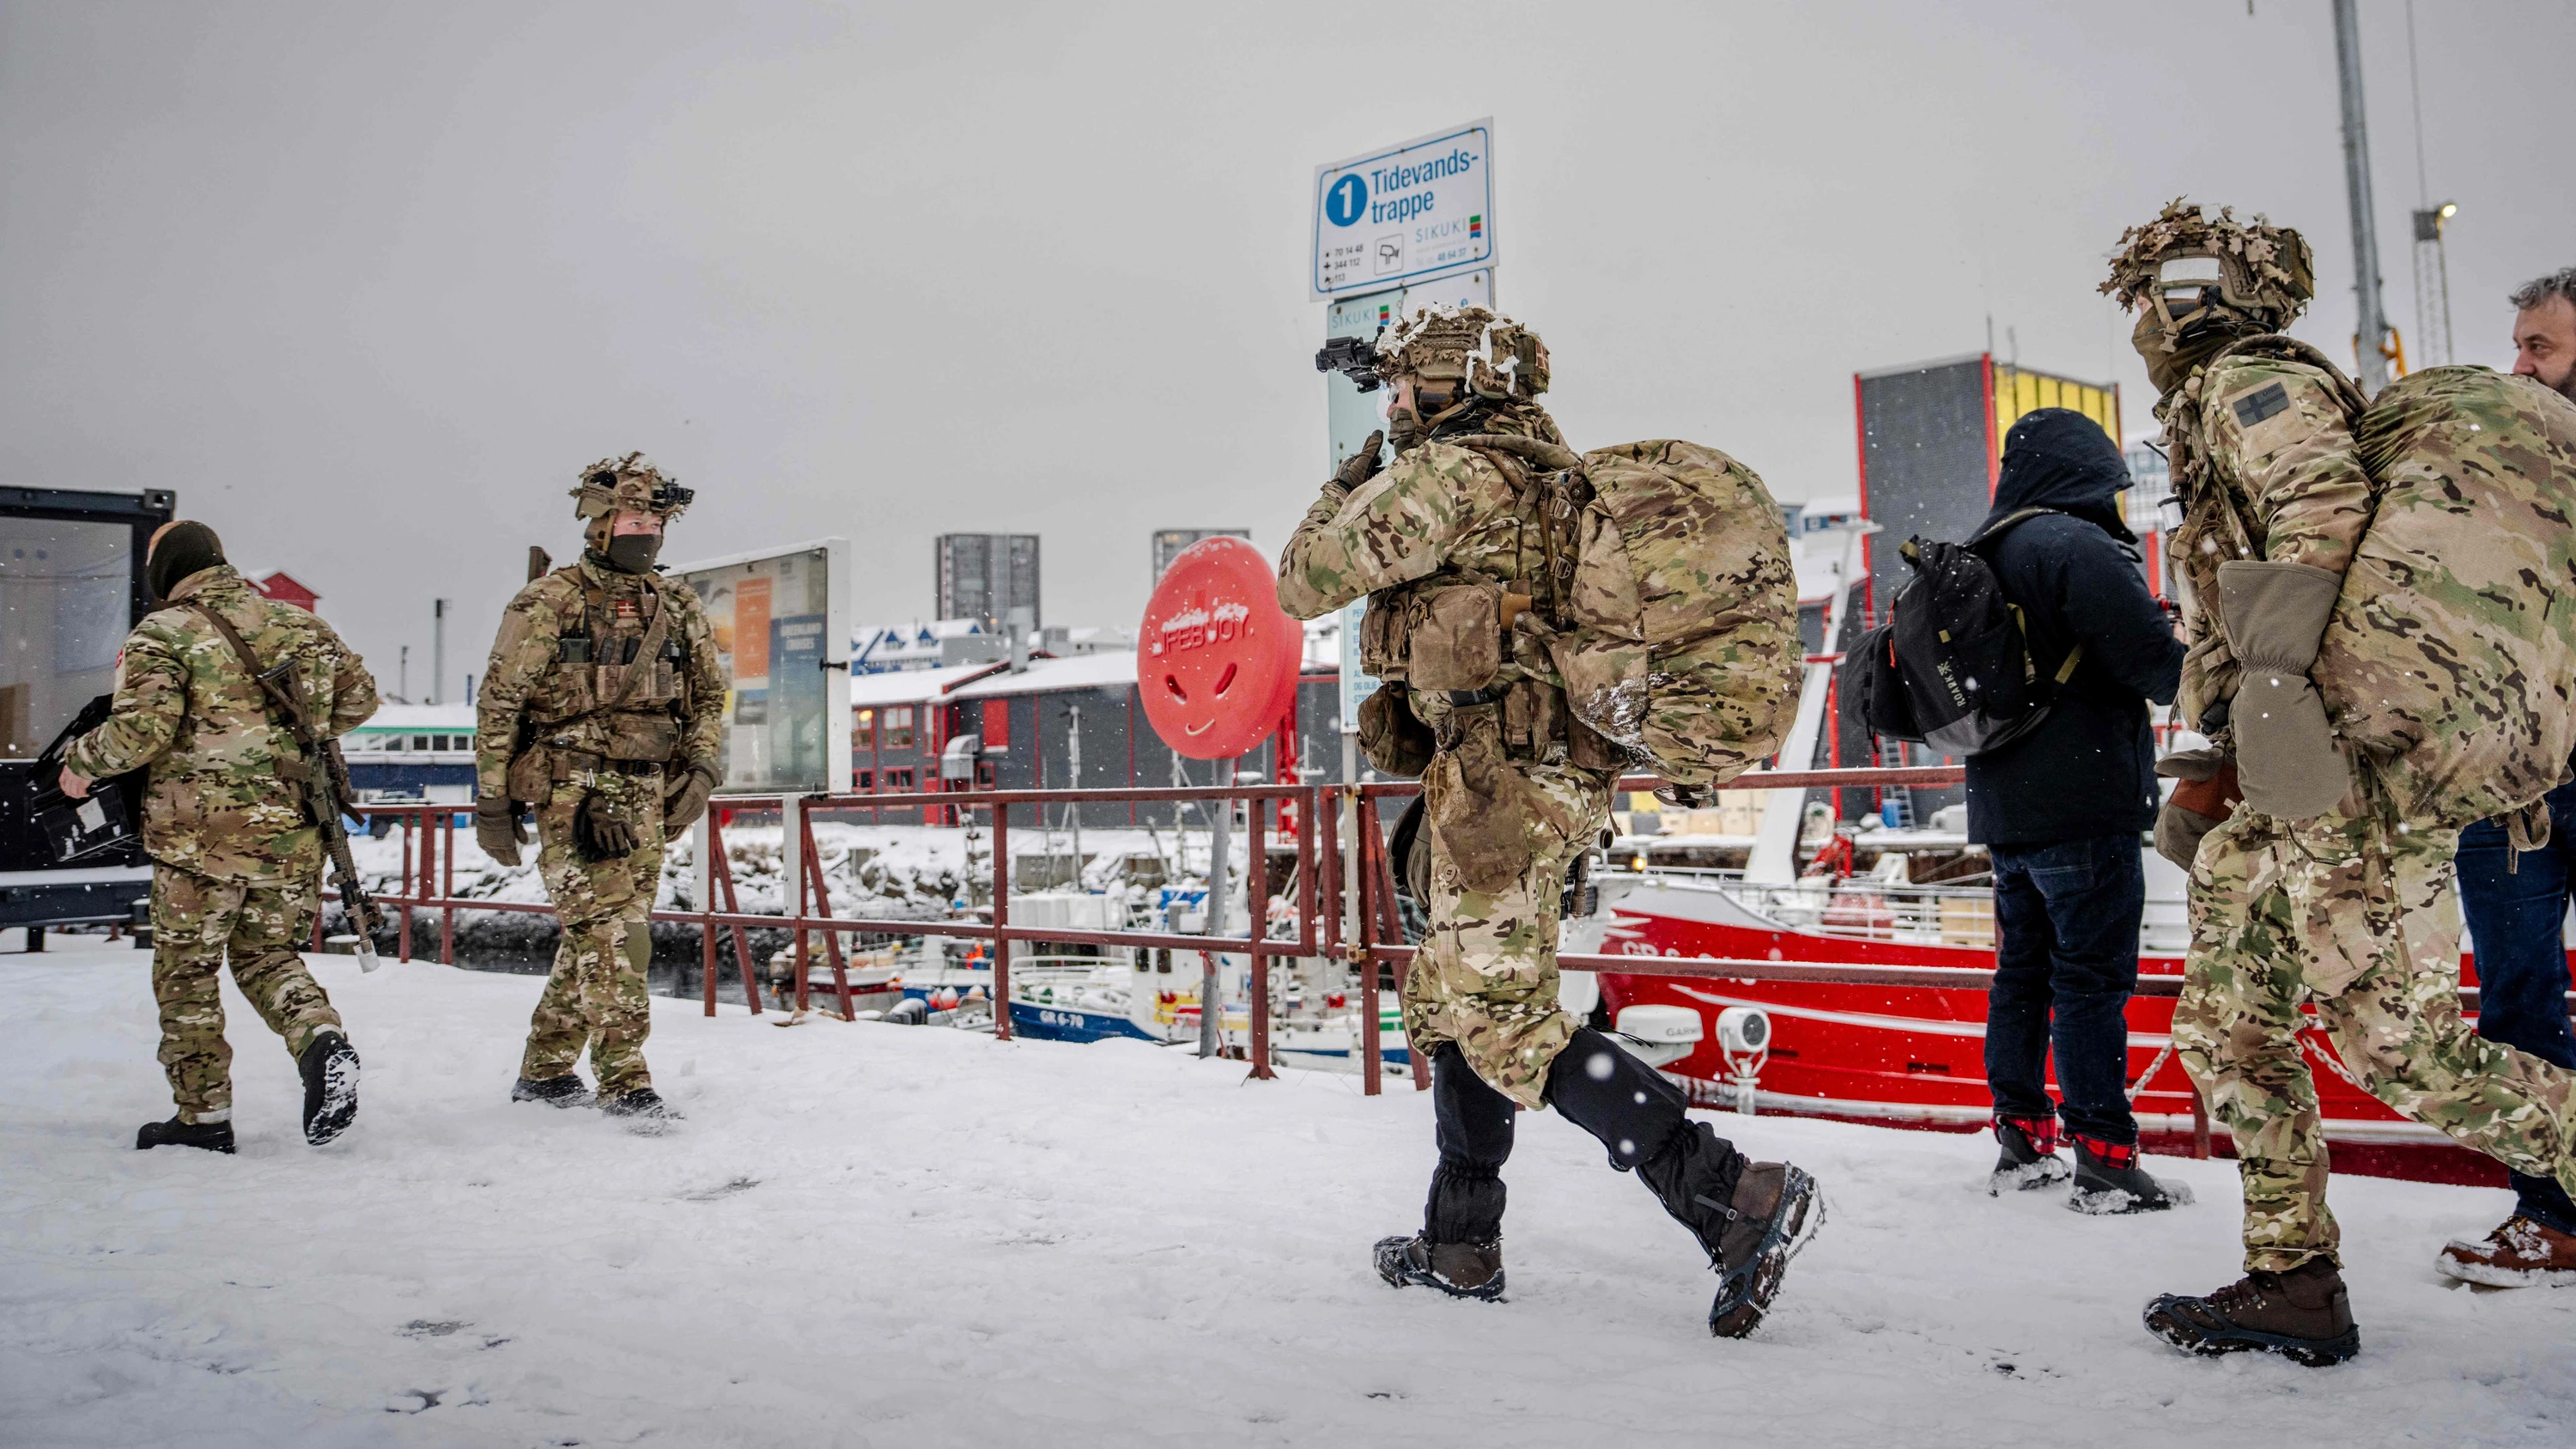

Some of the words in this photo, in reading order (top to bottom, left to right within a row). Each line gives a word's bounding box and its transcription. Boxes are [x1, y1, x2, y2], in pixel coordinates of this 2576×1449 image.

[1371, 149, 1479, 195] Tidevands-
[1338, 180, 1354, 219] 1
[1371, 190, 1434, 224] trappe
[1416, 217, 1467, 243] SIKUKI
[1332, 307, 1376, 329] SIKUKI
[1944, 673, 1966, 707] ROARK
